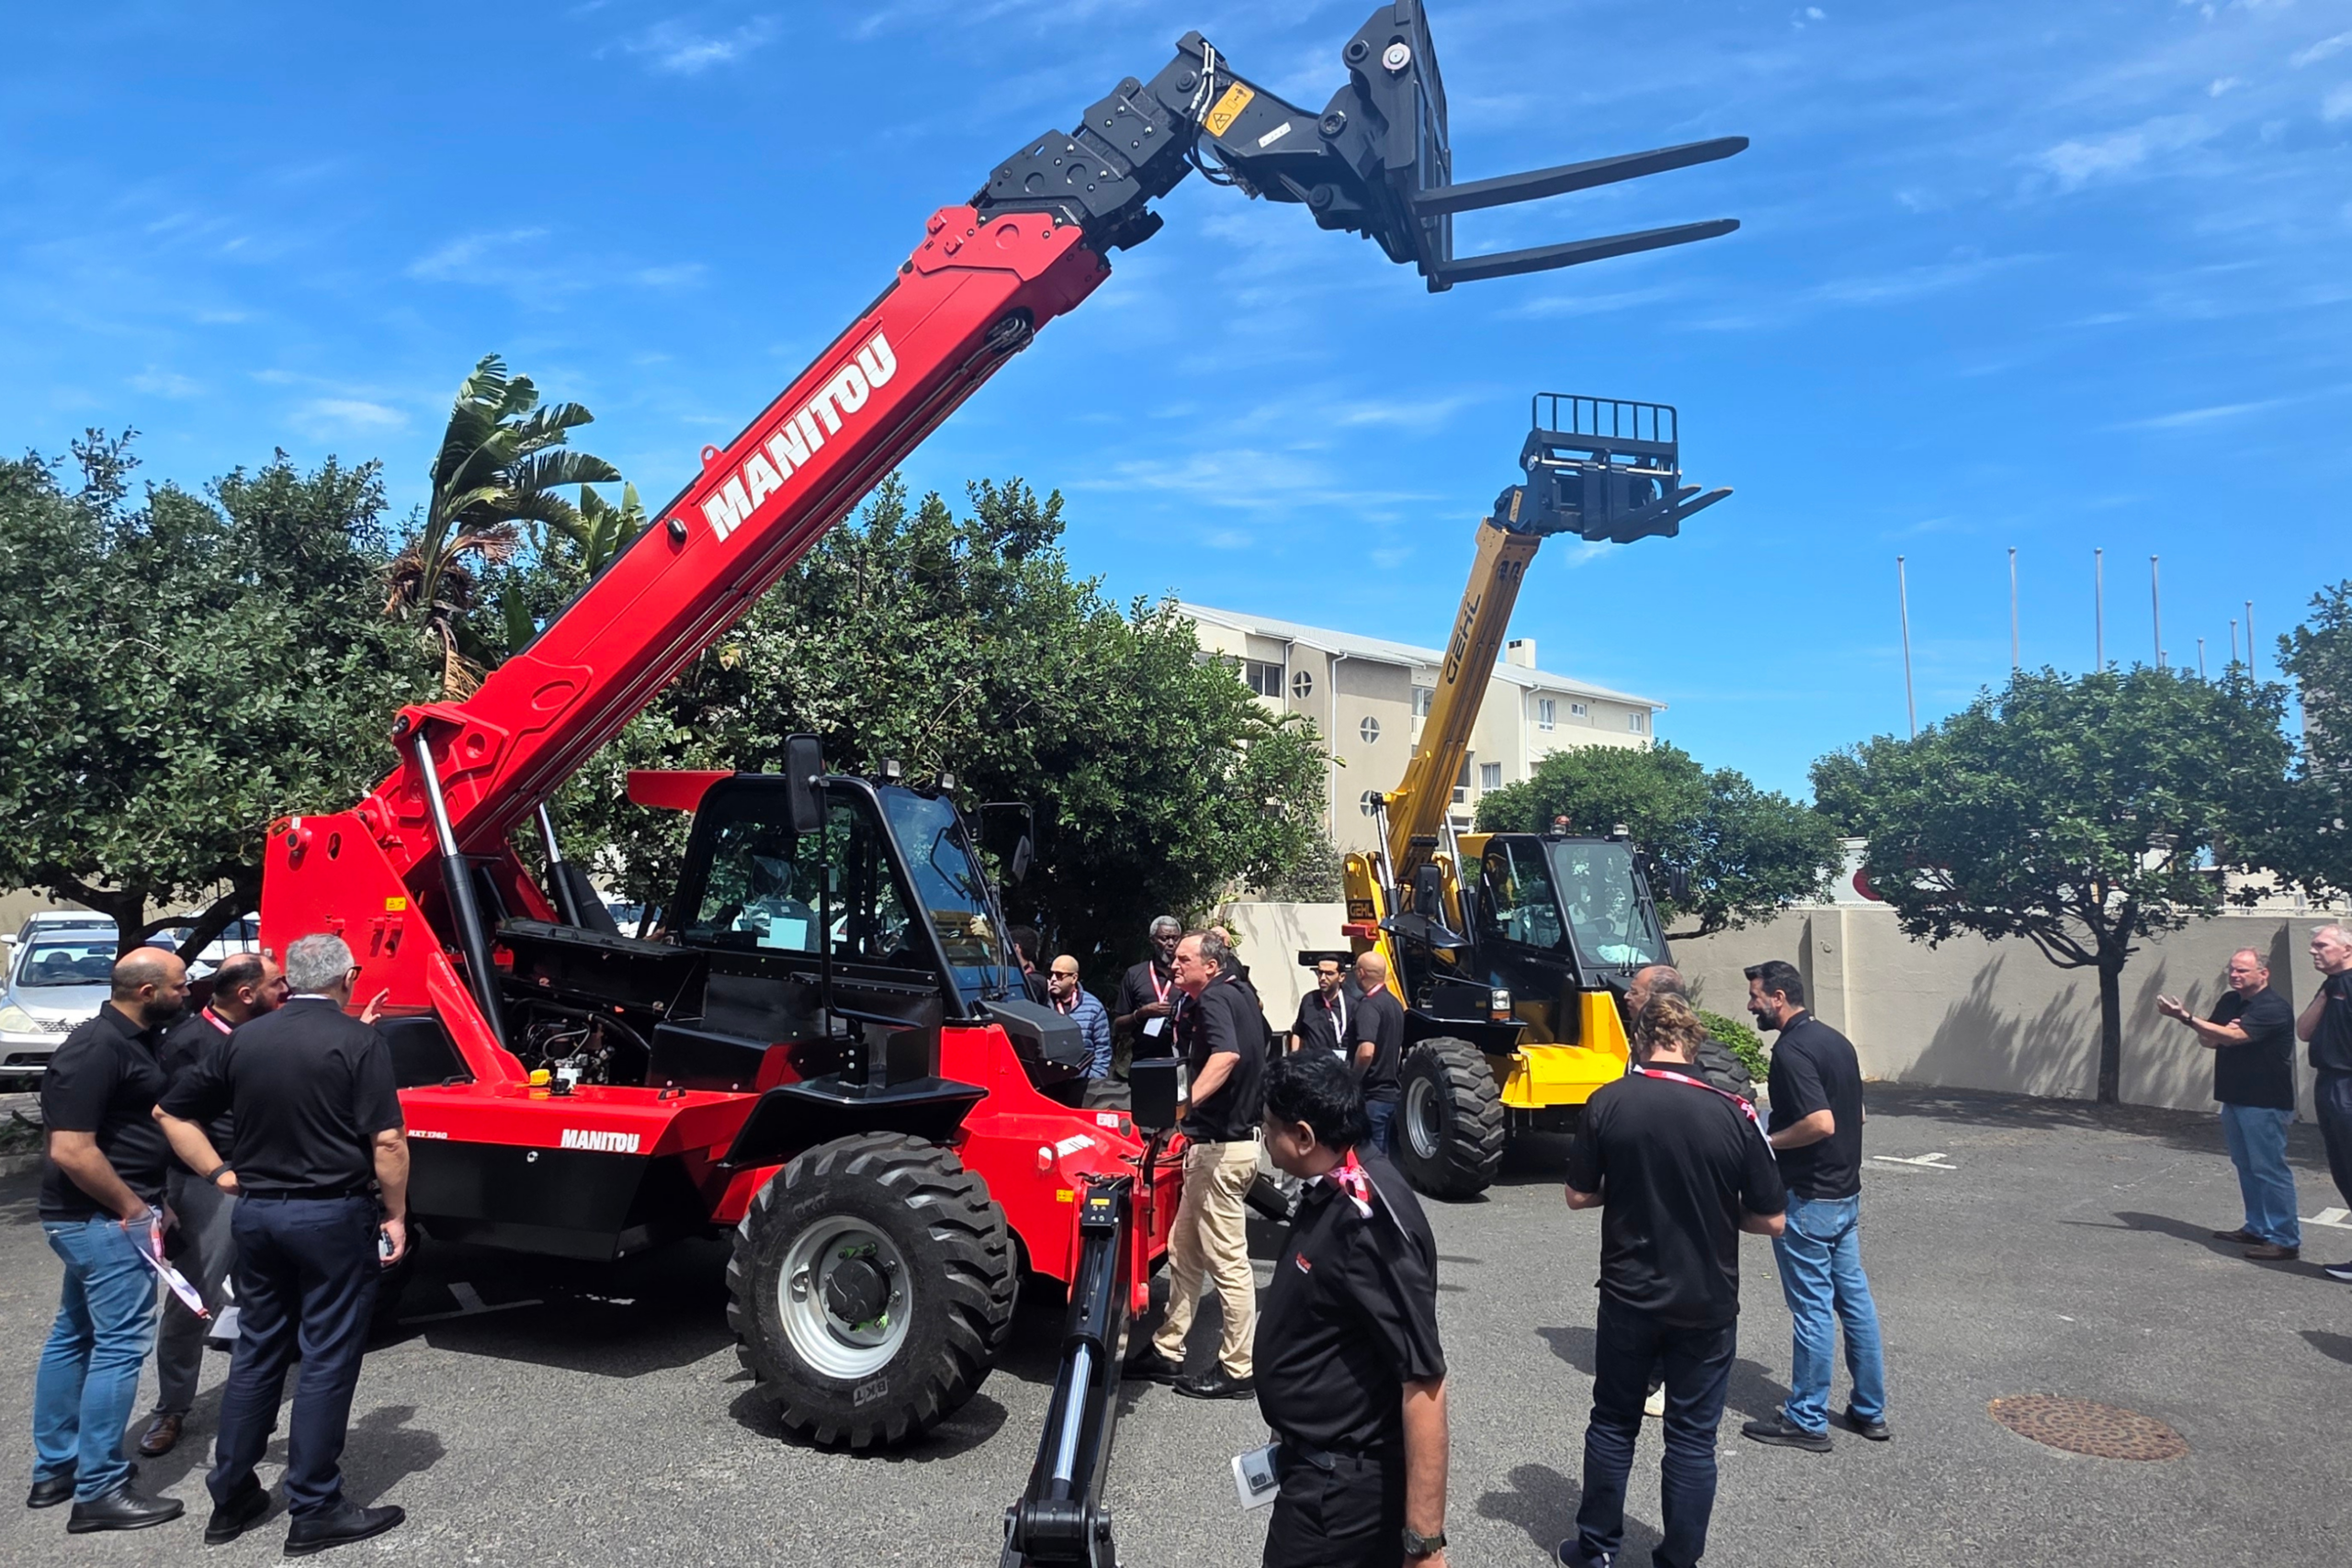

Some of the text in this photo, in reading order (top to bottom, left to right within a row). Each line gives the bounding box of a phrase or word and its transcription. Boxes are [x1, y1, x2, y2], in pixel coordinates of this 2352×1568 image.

[702, 332, 898, 544] MANITOU
[1445, 593, 1481, 685] GEHL
[1350, 903, 1374, 917] GEHL
[560, 1128, 640, 1153] MANITOU
[853, 1375, 888, 1407] BKT
